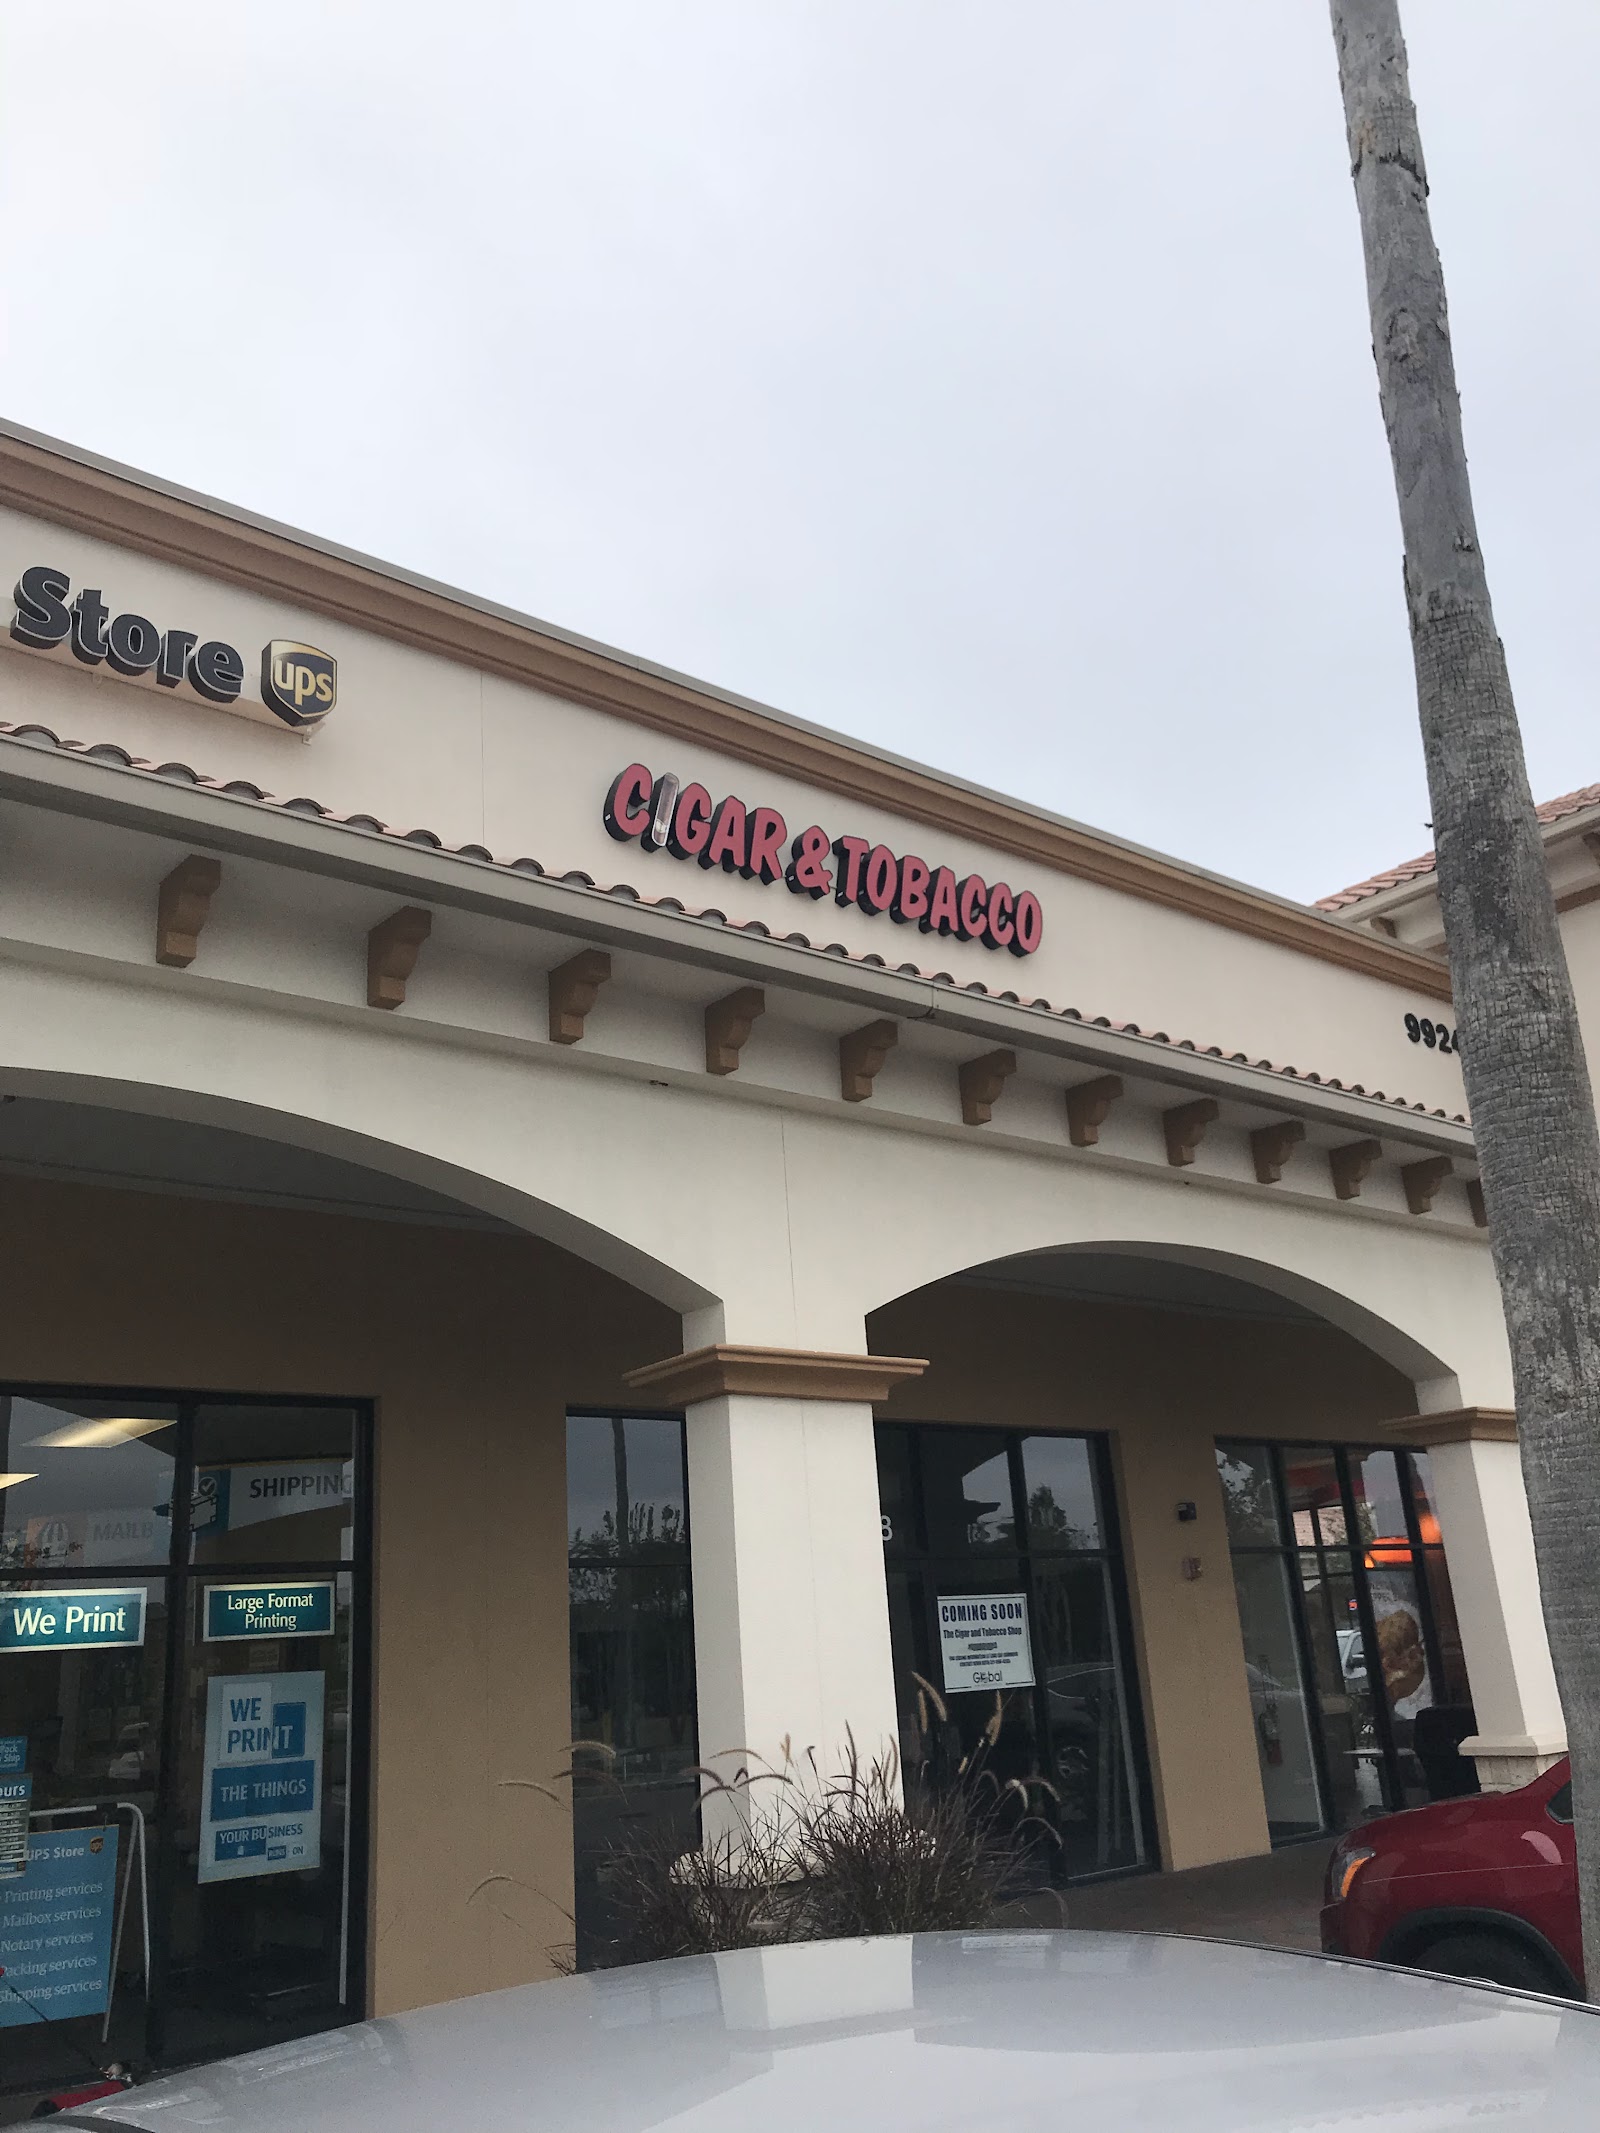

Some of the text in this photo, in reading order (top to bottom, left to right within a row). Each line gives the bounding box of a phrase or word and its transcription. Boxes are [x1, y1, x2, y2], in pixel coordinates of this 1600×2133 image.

[10, 566, 245, 702] Store
[273, 658, 334, 706] ups
[603, 763, 1043, 957] CIGAR & TOBACCO
[249, 1475, 352, 1499] SHIPPING
[227, 1592, 314, 1614] Large Format
[942, 1602, 1022, 1623] COMING SOON
[13, 1605, 126, 1636] We Print
[245, 1612, 297, 1631] Printing
[229, 1697, 262, 1722] WE
[227, 1725, 294, 1754] PRINT
[220, 1778, 307, 1802] THE THINGS
[220, 1823, 304, 1844] YOUR BUSINESS
[27, 1846, 85, 1861] UPS Store
[5, 1881, 103, 1904] Printing services
[2, 1906, 102, 1929] Mailbox services
[0, 1931, 94, 1954] Notary services
[48, 1955, 98, 1972] services
[53, 1979, 102, 1996] services
